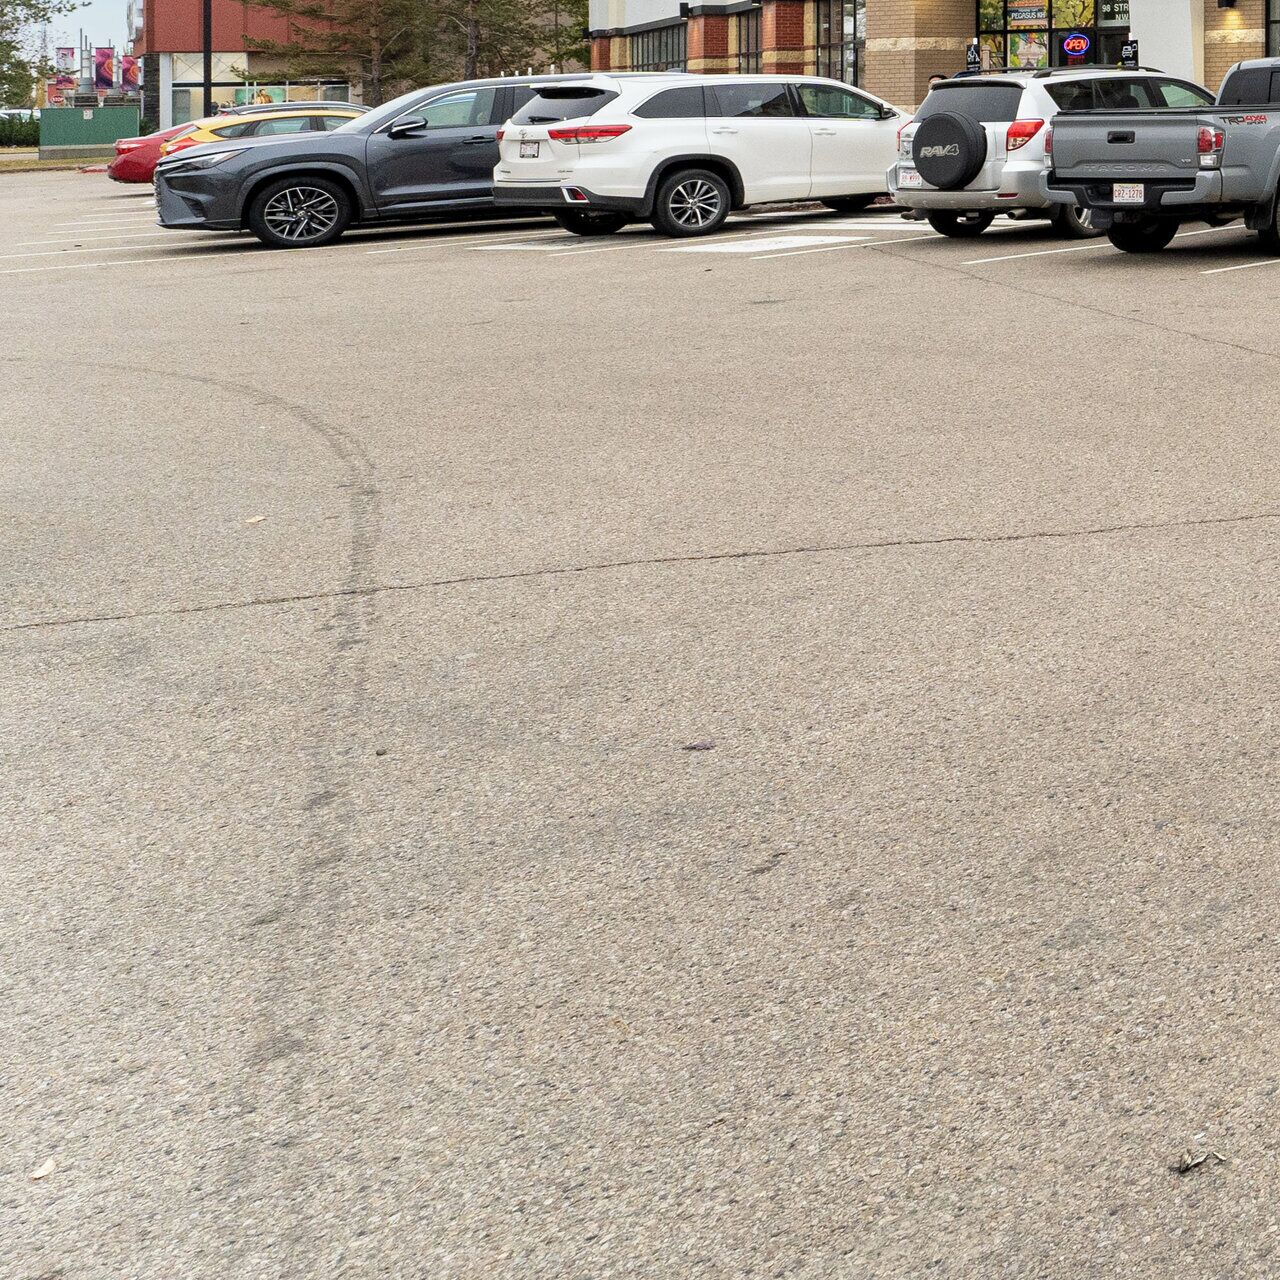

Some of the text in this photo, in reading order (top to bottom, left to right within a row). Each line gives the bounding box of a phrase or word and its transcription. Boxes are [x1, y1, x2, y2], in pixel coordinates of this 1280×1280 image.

[1101, 4, 1111, 13] 98
[1065, 39, 1087, 50] OPEN
[920, 143, 960, 159] RAV4
